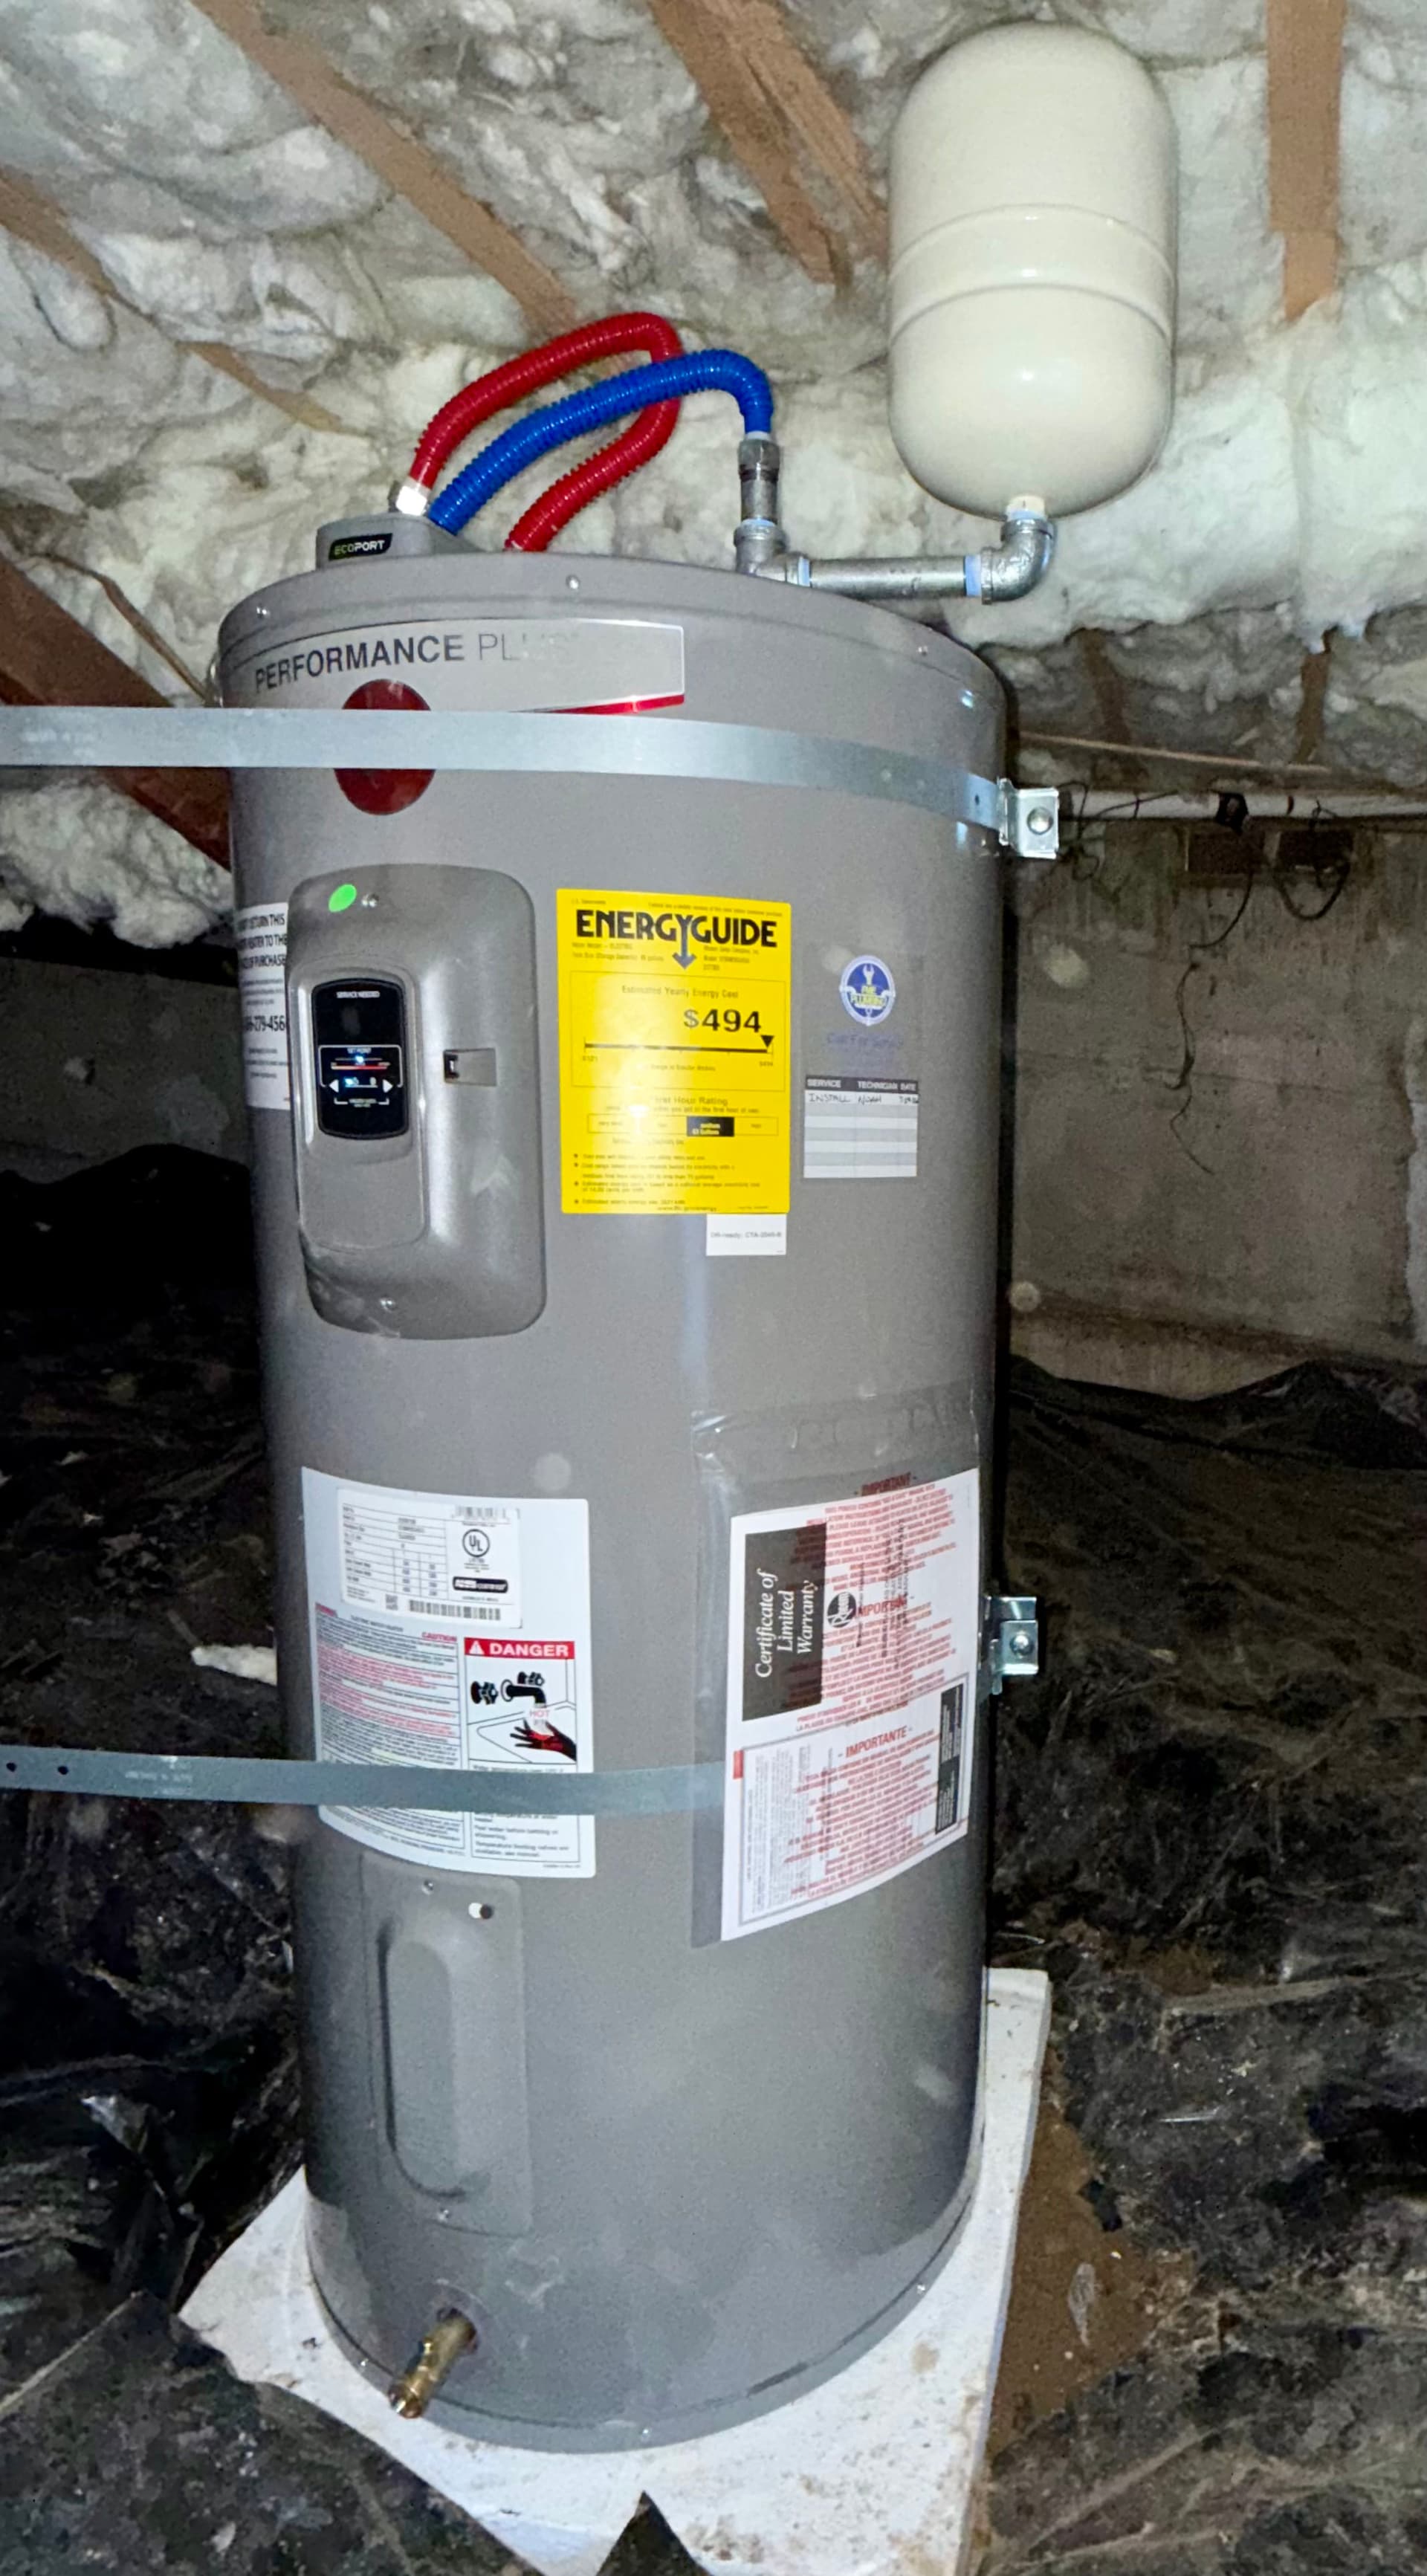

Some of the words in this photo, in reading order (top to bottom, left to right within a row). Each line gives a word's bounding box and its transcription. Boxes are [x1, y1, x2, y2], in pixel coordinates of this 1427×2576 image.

[334, 540, 385, 556] ECOPORT
[255, 633, 465, 692] PERFORMANCE
[575, 909, 777, 951] ENERGYGUIDE
[664, 986, 690, 998] Yearly
[692, 988, 719, 1000] Energy
[683, 1008, 762, 1033] $494
[806, 1078, 841, 1088] SERVICE
[699, 1096, 728, 1107] Rating
[468, 1535, 483, 1552] UL
[757, 1567, 779, 1589] of
[777, 1590, 795, 1653] Limited
[797, 1579, 818, 1654] Warranty
[421, 1631, 457, 1642] CAUTION
[755, 1591, 773, 1677] Certificate
[488, 1642, 569, 1657] DANGER
[529, 1708, 550, 1718] HOT
[846, 1725, 908, 1758] IMPORTANTE
